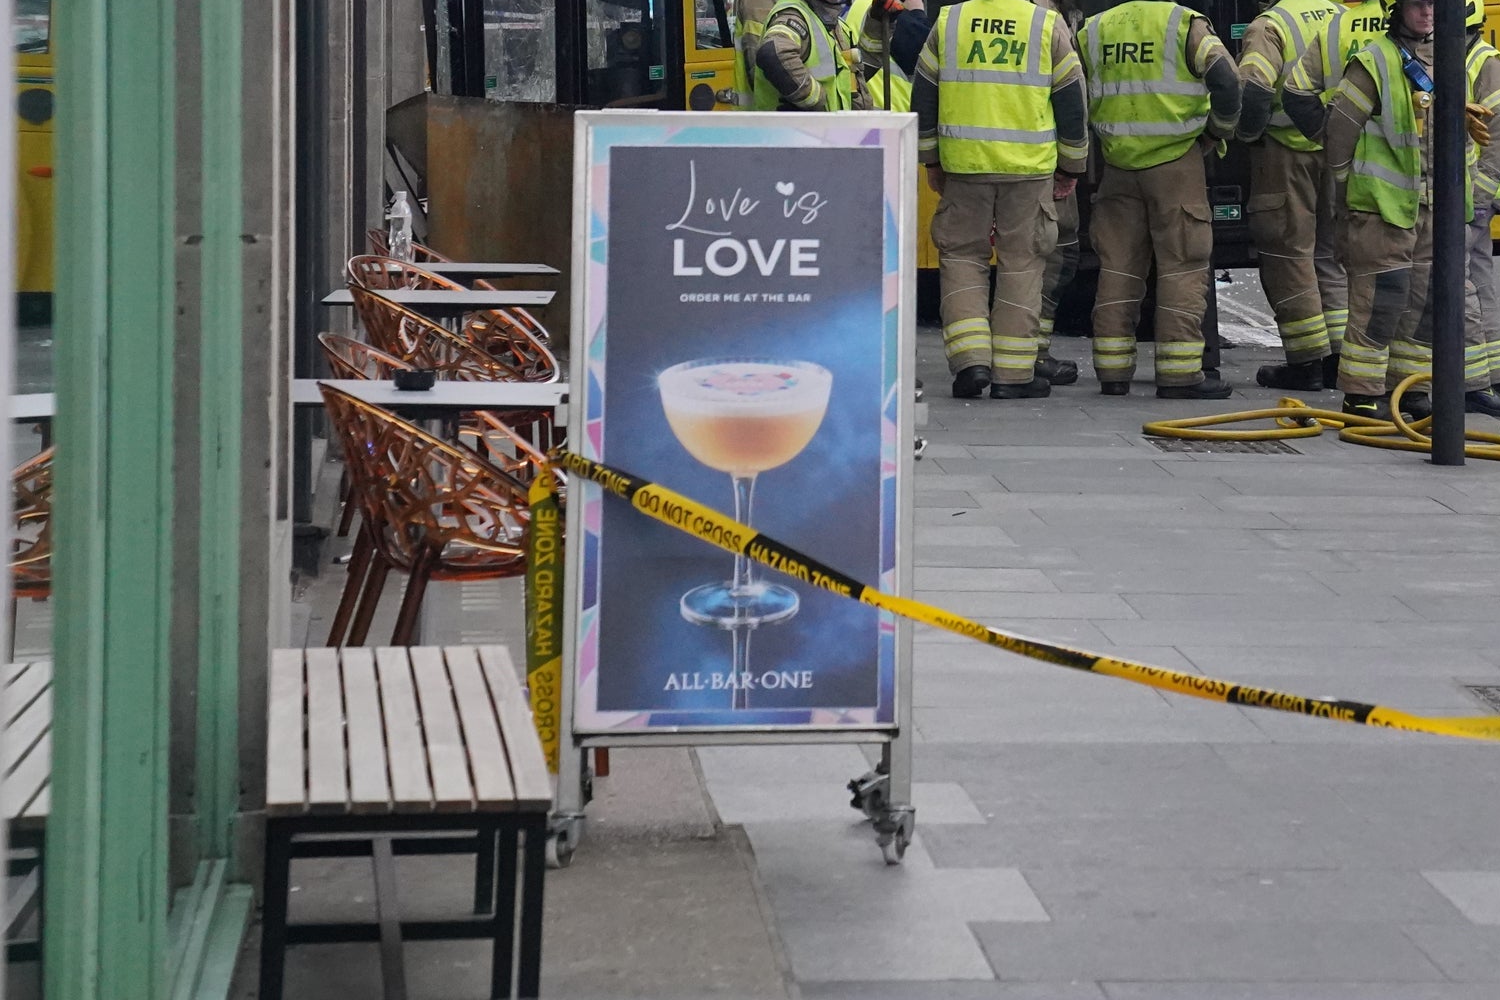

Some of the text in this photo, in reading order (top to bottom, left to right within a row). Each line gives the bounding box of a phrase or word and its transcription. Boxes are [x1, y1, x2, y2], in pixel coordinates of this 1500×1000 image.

[970, 18, 1017, 36] FIRE
[966, 37, 1027, 66] A24
[1103, 42, 1155, 65] FIRE
[665, 159, 828, 236] Love is
[673, 238, 820, 277] LOVE
[679, 293, 811, 303] ORDER ME AT THE BAR
[592, 463, 632, 497] ZONE
[638, 489, 743, 552] DO NOT CROSS
